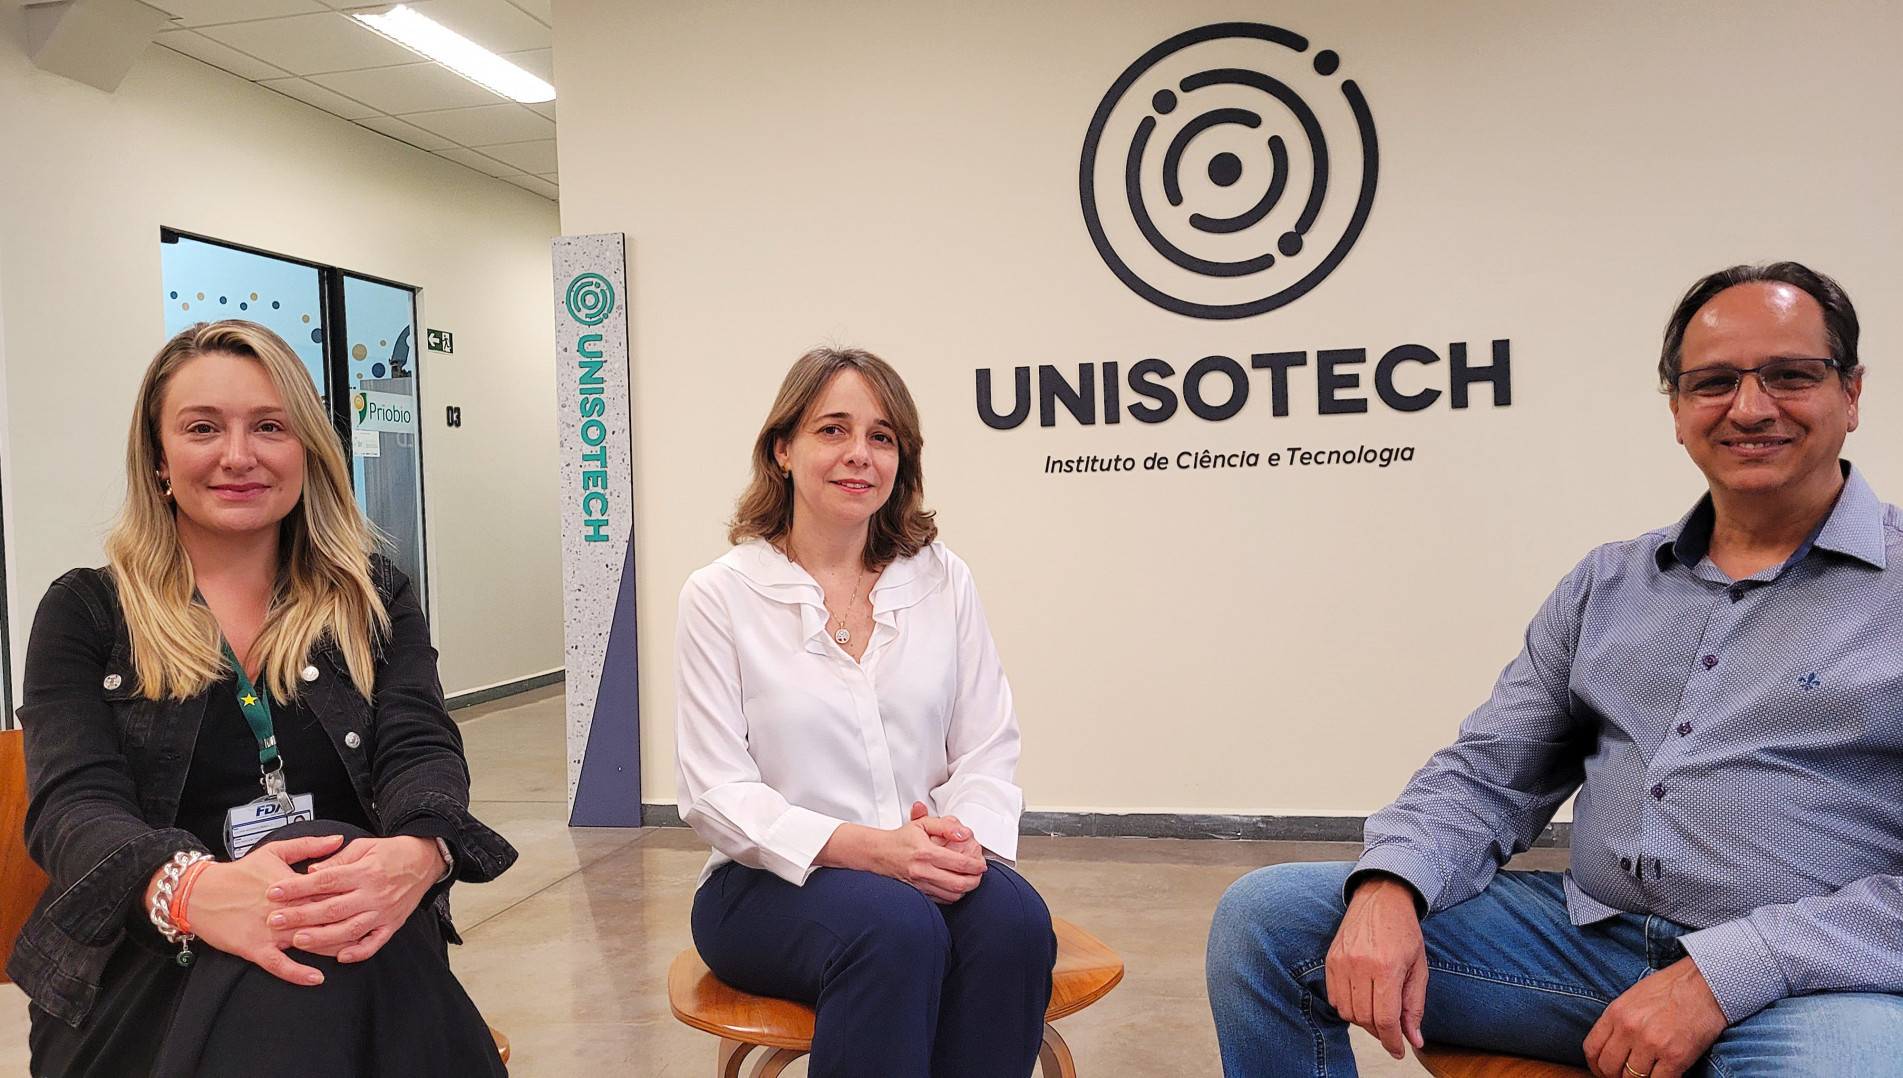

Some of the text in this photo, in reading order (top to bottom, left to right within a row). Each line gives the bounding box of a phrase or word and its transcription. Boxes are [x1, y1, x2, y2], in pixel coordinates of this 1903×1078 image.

[975, 338, 1512, 430] UNISOTECH
[369, 402, 411, 424] Priobio
[446, 405, 462, 429] 03
[577, 333, 610, 543] UNISOTECH
[1044, 444, 1415, 474] Instituto de Ciência e Tecnologia
